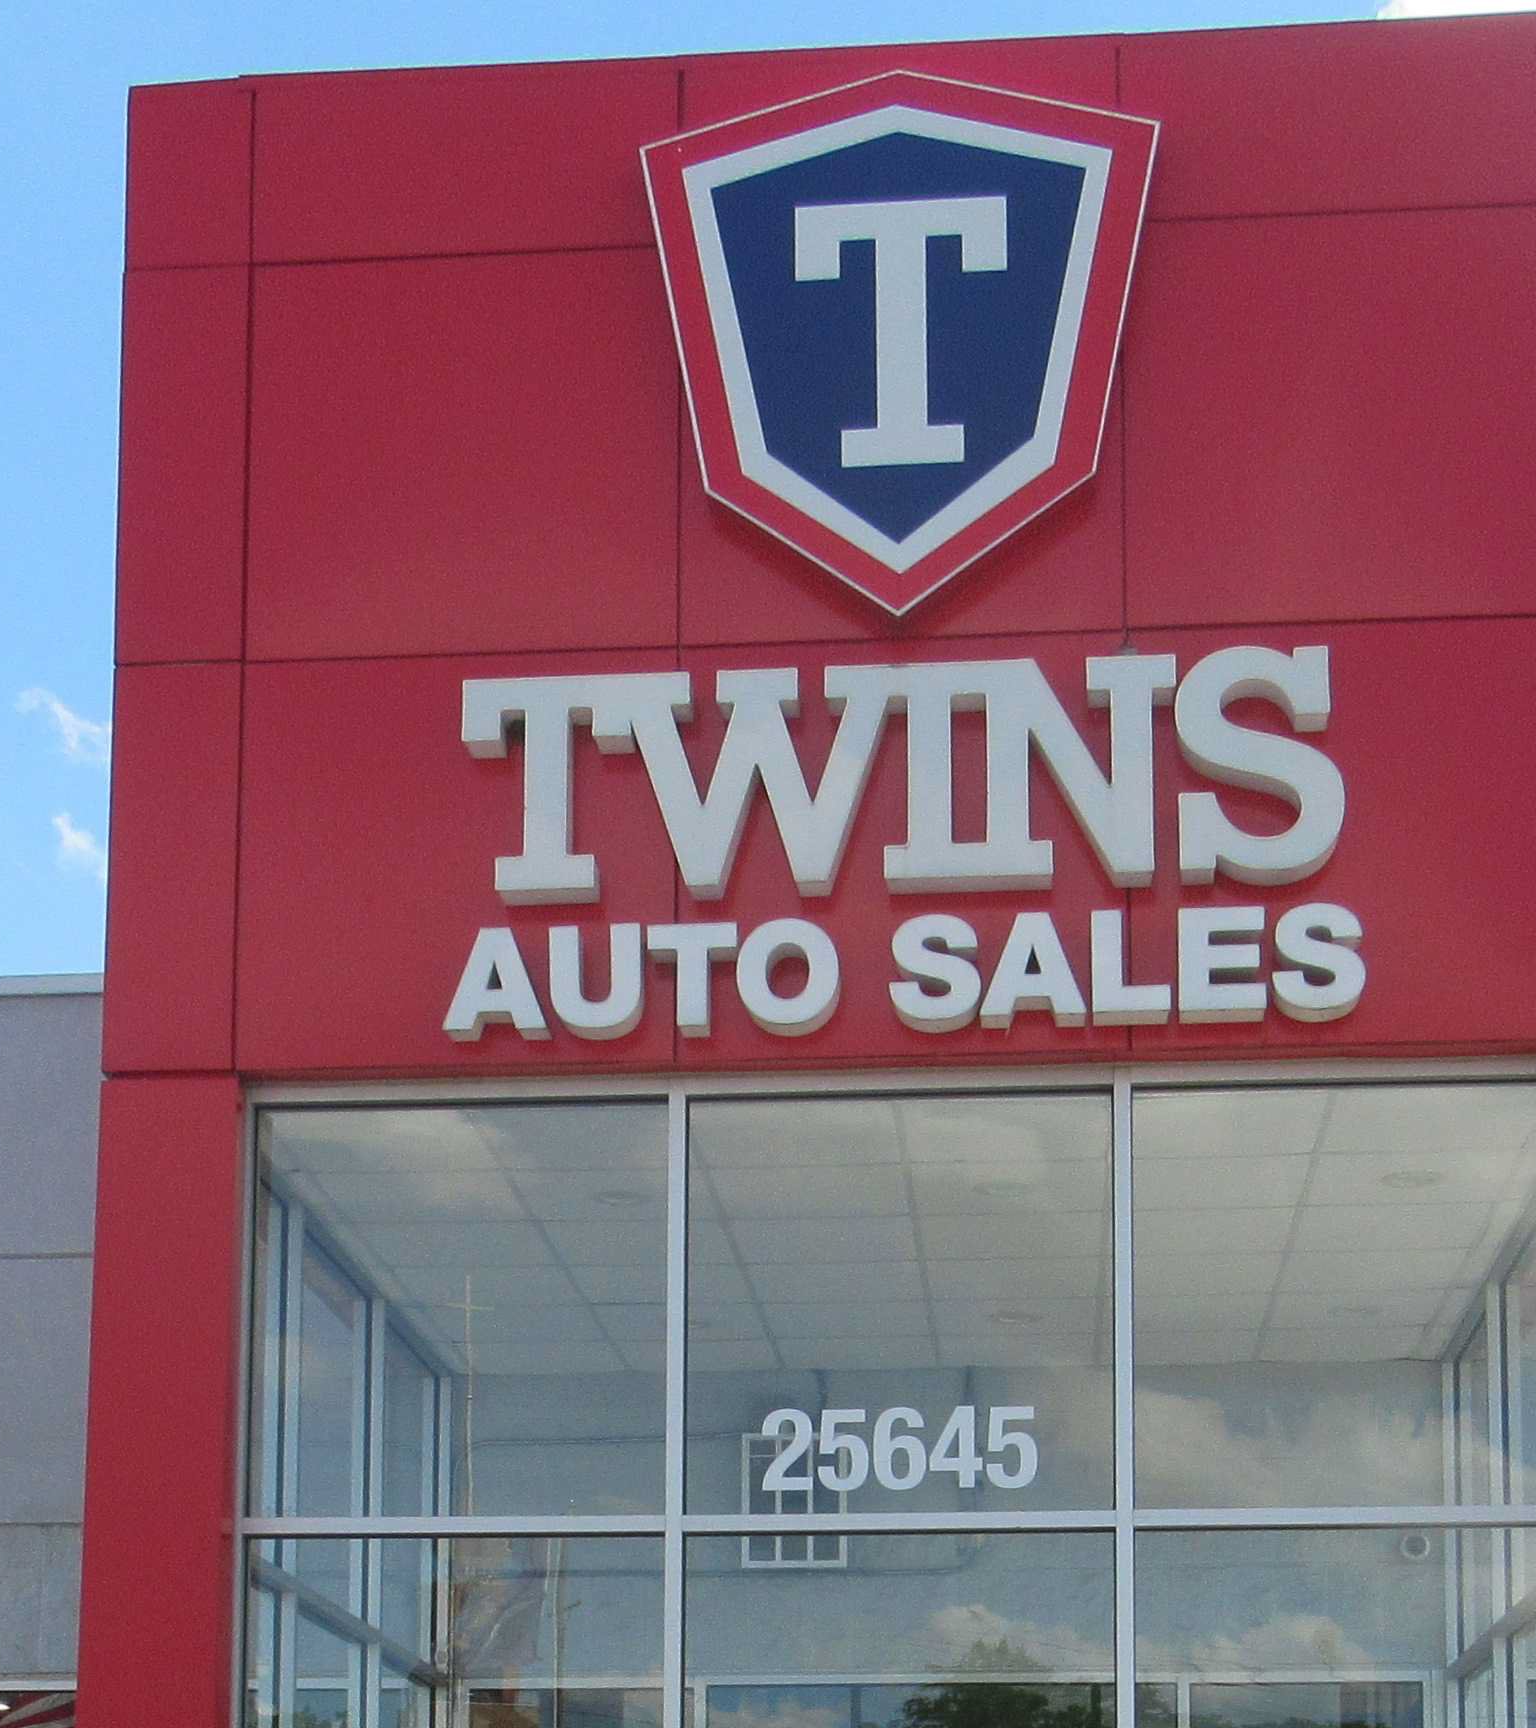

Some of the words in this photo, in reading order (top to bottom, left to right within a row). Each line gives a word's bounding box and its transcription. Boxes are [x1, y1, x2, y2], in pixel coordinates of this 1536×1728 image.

[794, 196, 1007, 468] T
[461, 645, 1346, 905] TWINS
[443, 918, 841, 1041] AUTO
[889, 903, 1366, 1034] SALES
[761, 1405, 1039, 1492] 25645
